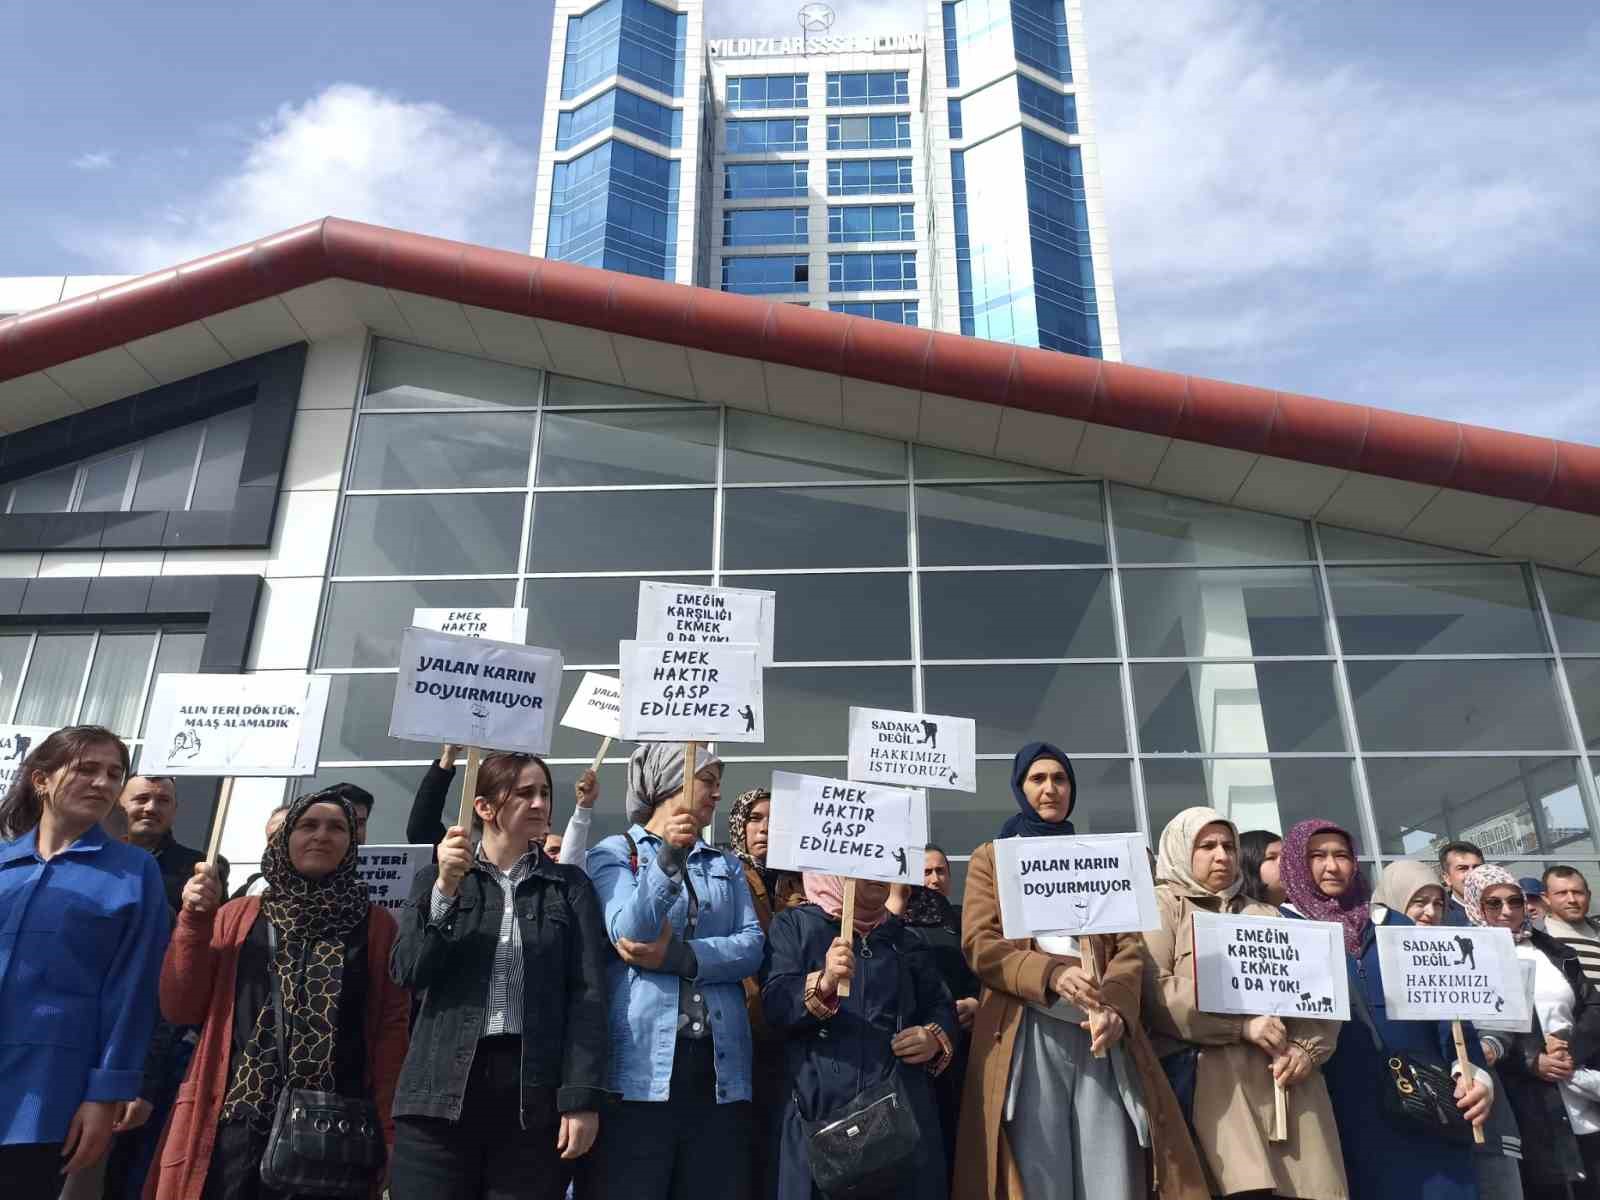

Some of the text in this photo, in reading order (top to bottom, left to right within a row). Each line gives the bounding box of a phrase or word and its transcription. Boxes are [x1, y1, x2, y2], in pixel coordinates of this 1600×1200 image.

[709, 37, 802, 57] YILDIZLAR
[677, 593, 724, 607] EMEĞİN
[448, 612, 481, 621] EMEK
[667, 606, 732, 622] KARŞILIĞI
[441, 622, 487, 631] HAKTIR
[677, 620, 720, 633] EKMEK
[662, 650, 709, 665] EMEK
[416, 656, 536, 684] YALAN KARIN
[653, 667, 718, 682] HAKTIR
[415, 681, 543, 709] DOYURMUYOR
[592, 687, 620, 698] YALA
[663, 685, 710, 701] GASP
[179, 705, 209, 714] ALIN
[587, 699, 620, 712] DOYUR
[185, 718, 289, 730] MAAŞ ALAMADIK
[871, 720, 920, 733] SADAKA
[879, 731, 914, 745] DEĞİL
[870, 747, 946, 763] HAKKIMIZI
[822, 786, 866, 804] EMEK
[813, 802, 875, 822] HAKTIR
[822, 821, 866, 838] GASP
[1020, 857, 1119, 875] YALAN KARIN
[1024, 879, 1132, 897] DOYURMUYOR
[1236, 928, 1289, 944] EMEĞİN
[1228, 944, 1300, 963] KARŞILIĞI
[1402, 940, 1456, 952] SADAKA
[1413, 952, 1451, 967] DEĞİL
[1241, 960, 1289, 976] EKMEK
[1245, 977, 1264, 991] DA
[1270, 979, 1300, 994] YOK!
[1406, 974, 1488, 987] HAKKIMIZI
